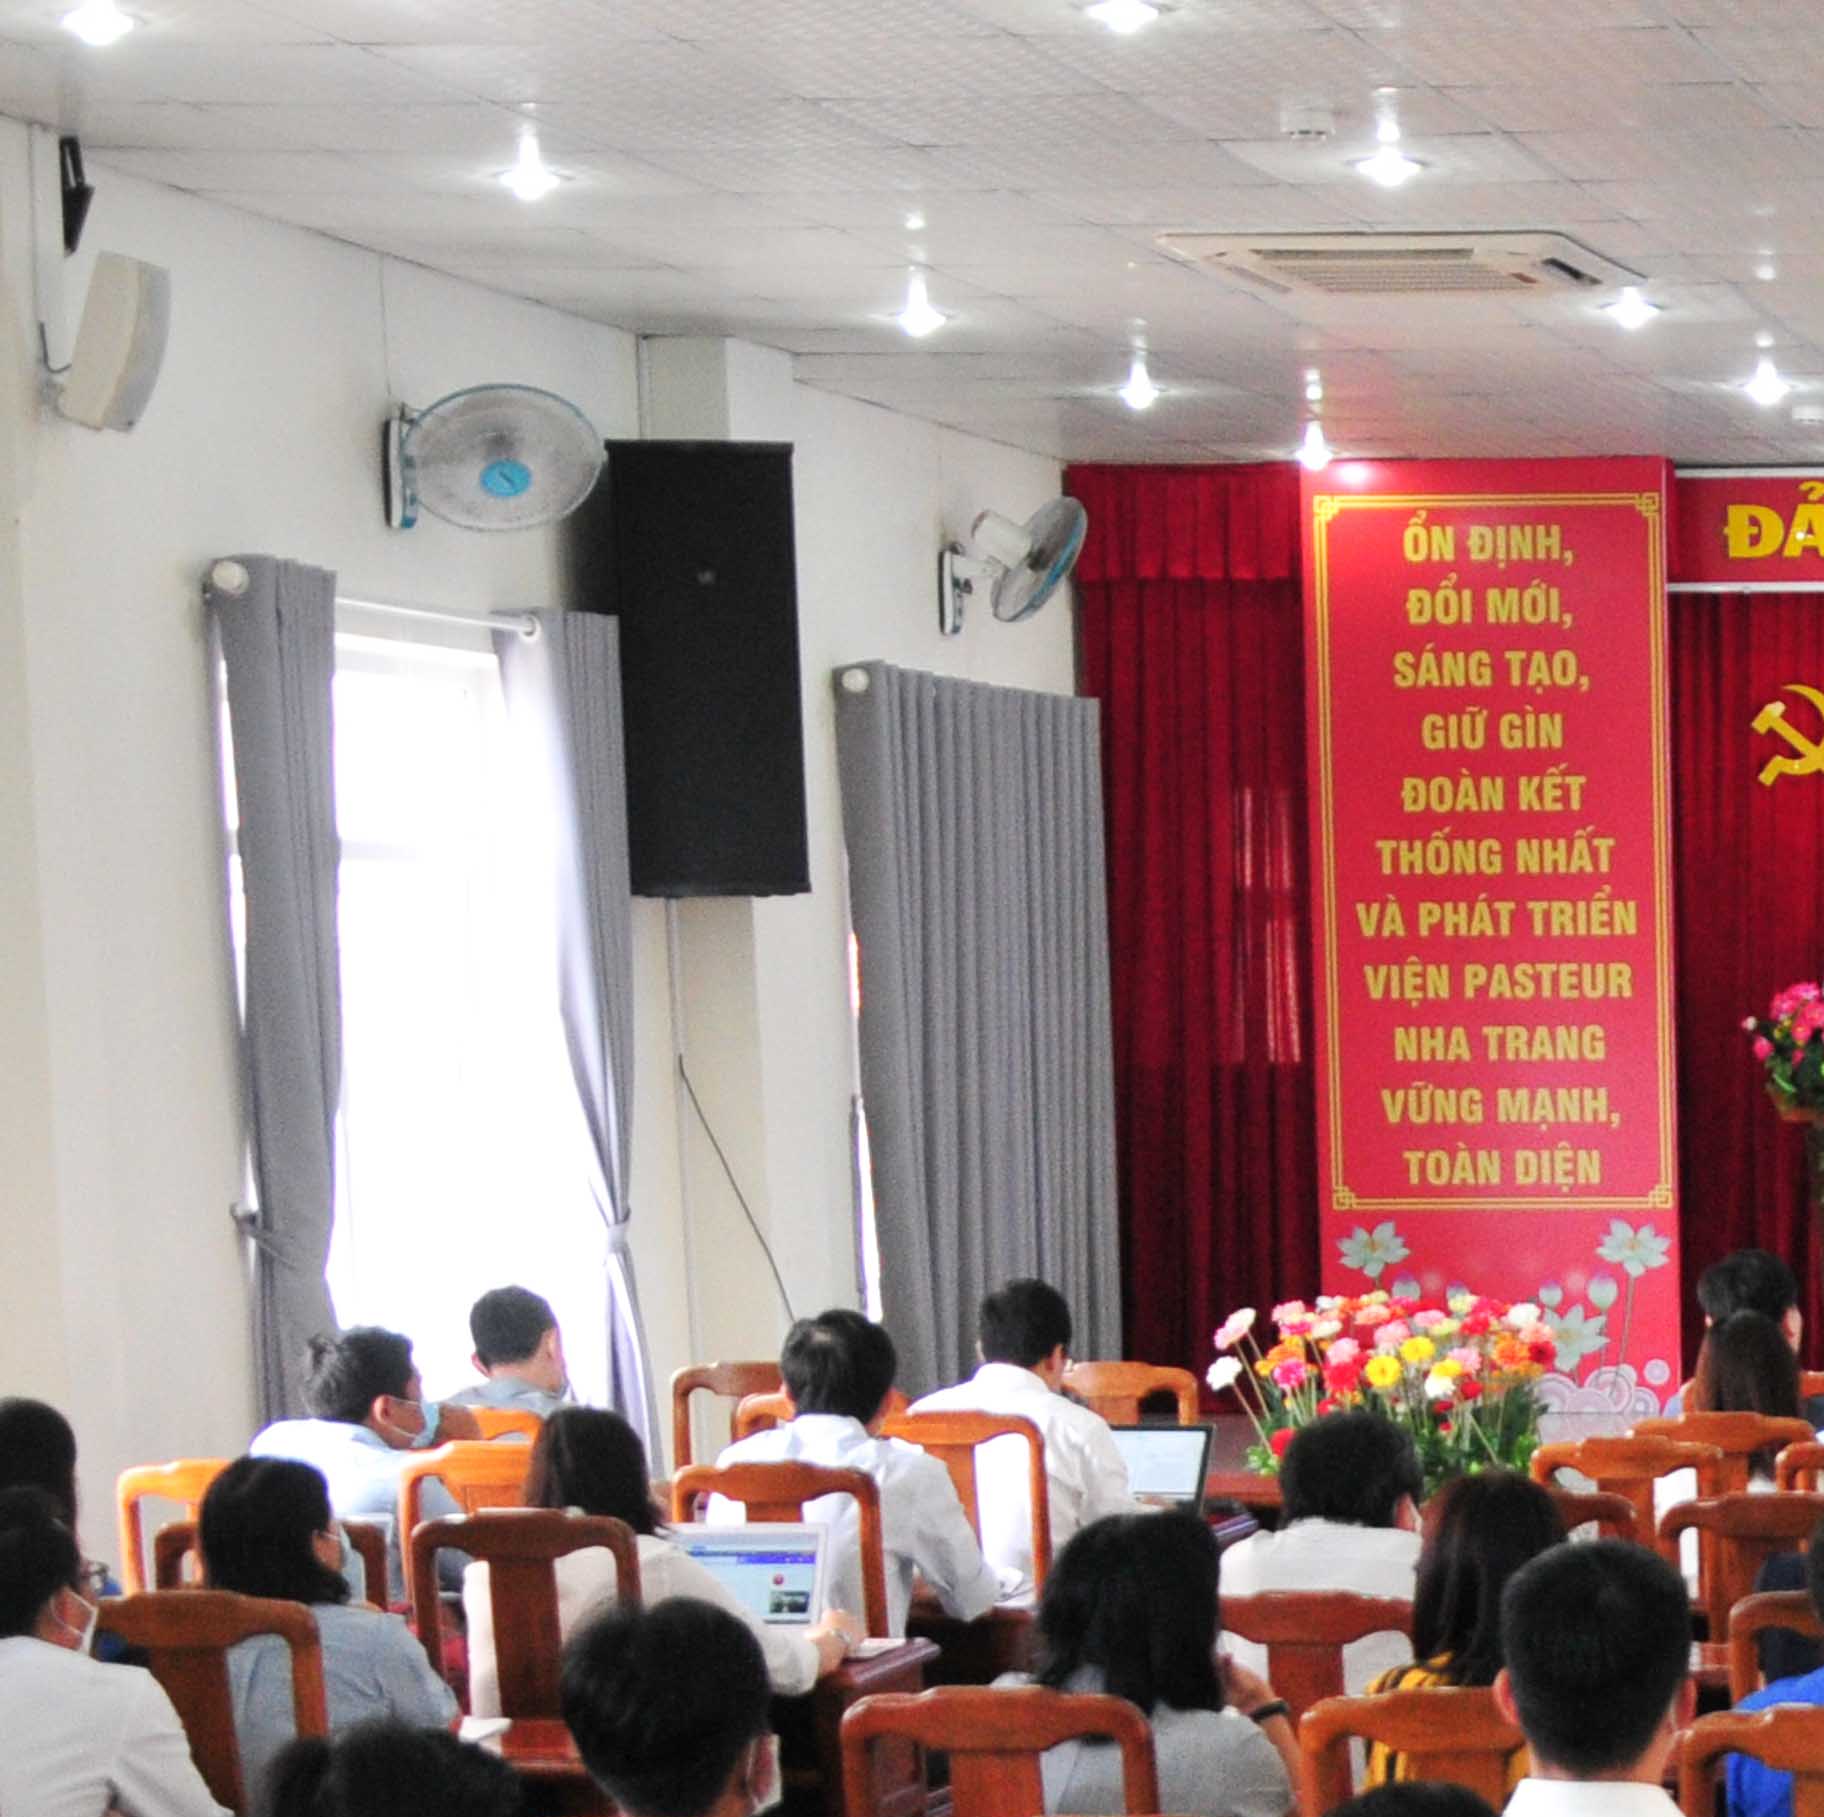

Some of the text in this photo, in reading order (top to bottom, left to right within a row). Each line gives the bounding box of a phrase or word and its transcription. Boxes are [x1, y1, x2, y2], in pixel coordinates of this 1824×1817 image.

[1403, 510, 1573, 569] ỔN ĐỊNH,
[1407, 573, 1573, 629] ĐỔI MỚI,
[1393, 643, 1590, 694] SÁNG TẠO,
[1421, 706, 1563, 750] GIỮ GÌN
[1401, 763, 1586, 813] ĐOÀN KẾT
[1376, 826, 1615, 876] THỐNG NHẤT
[1355, 885, 1638, 937] VÀ PHÁT TRIỂN
[1364, 956, 1633, 1009] VIỆN PASTEUR
[1393, 1025, 1605, 1062] NHA TRANG
[1380, 1082, 1620, 1132] VỮNG MẠNH,
[1403, 1142, 1602, 1192] TOÀN DIỆN
